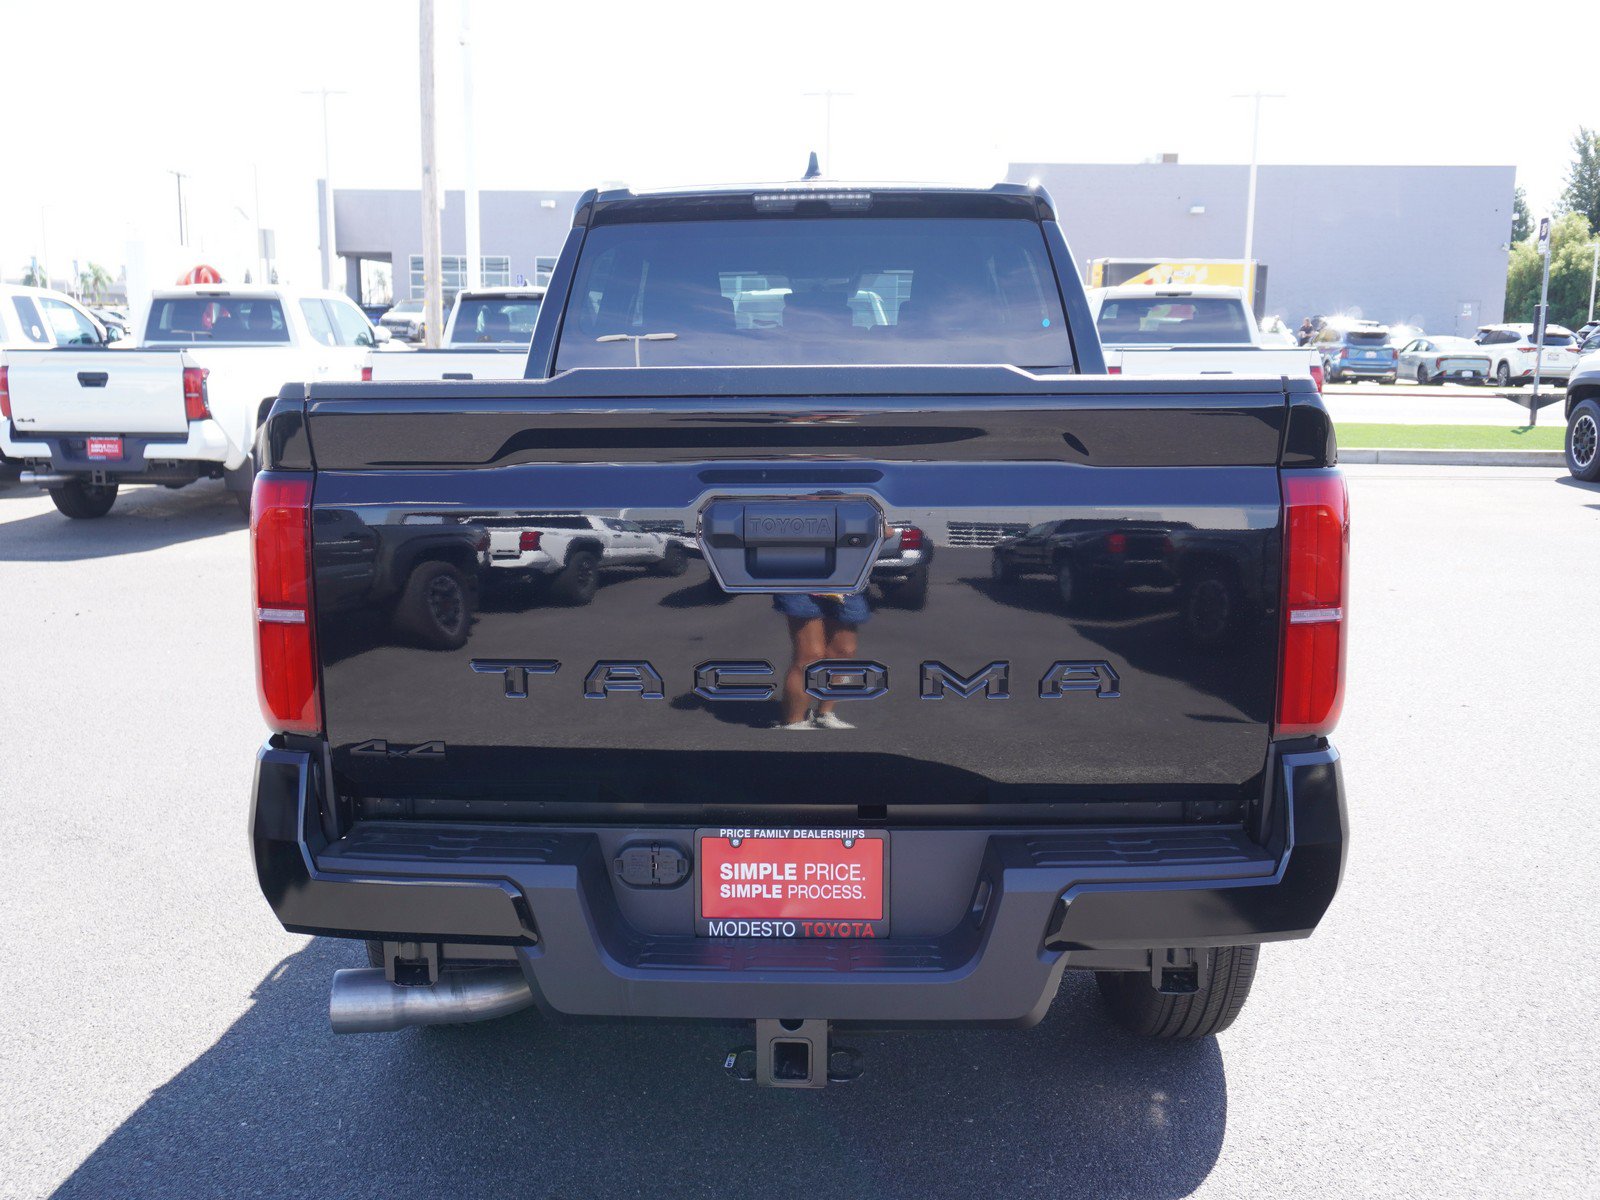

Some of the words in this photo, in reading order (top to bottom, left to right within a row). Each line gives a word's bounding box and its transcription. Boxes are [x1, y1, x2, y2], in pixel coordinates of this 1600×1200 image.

[751, 517, 832, 535] TOYOTA
[470, 659, 1121, 701] TACOMA
[719, 828, 751, 838] PRICE
[754, 829, 790, 838] FAMILY
[793, 830, 865, 839] DEALERSHIPS
[720, 863, 797, 880] SIMPLE
[804, 864, 866, 881] PRICE.
[720, 884, 782, 898] SIMPLE
[788, 885, 866, 900] PROCESS.
[709, 921, 796, 937] MODESTO
[804, 923, 874, 937] TOYOTA
